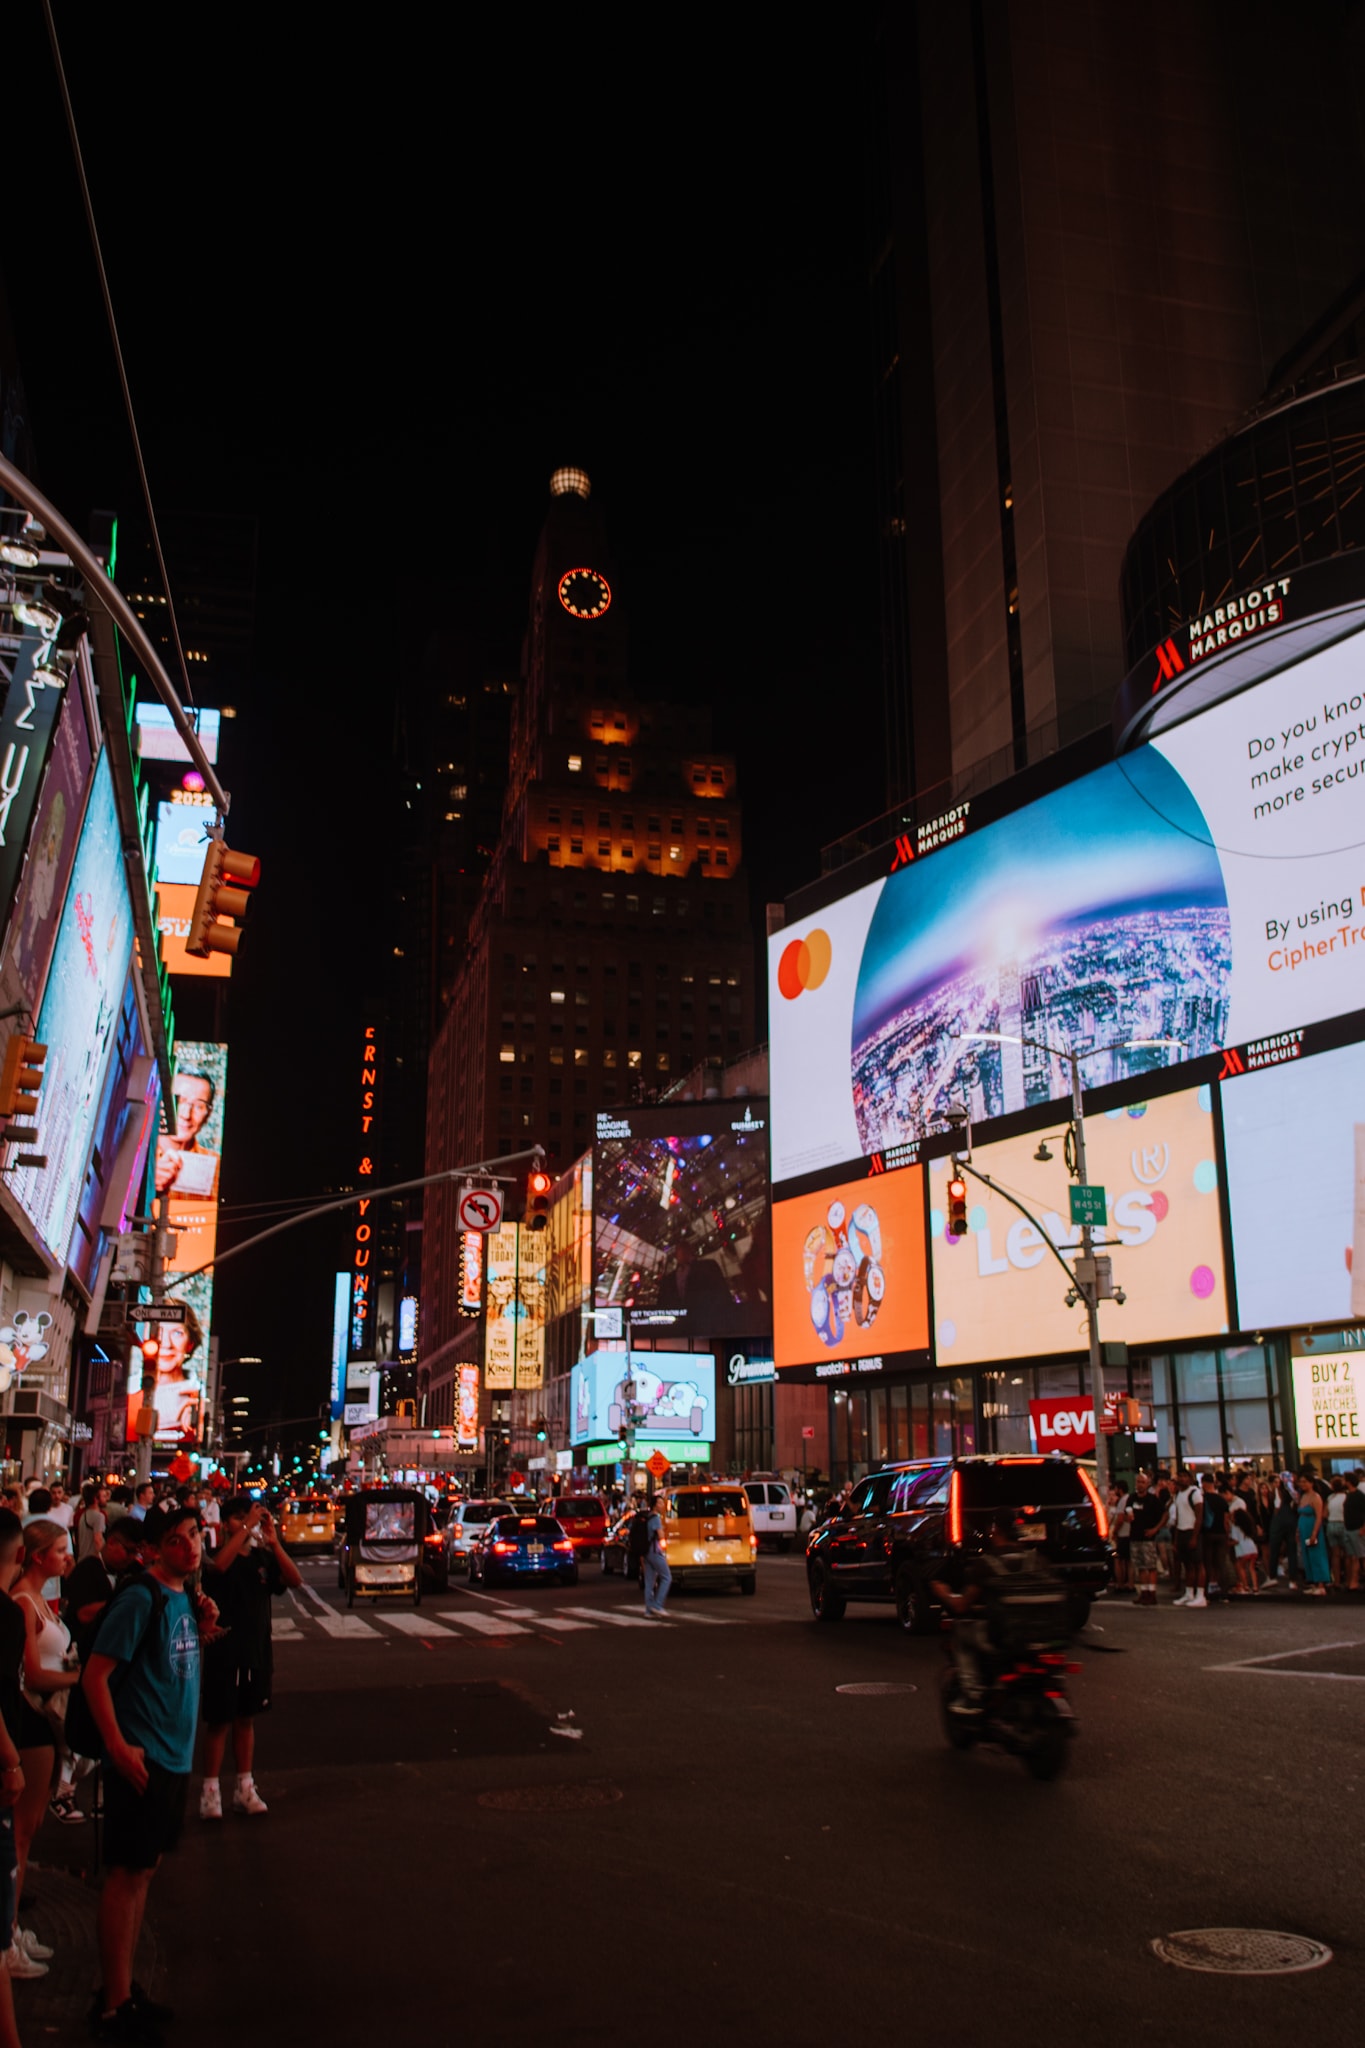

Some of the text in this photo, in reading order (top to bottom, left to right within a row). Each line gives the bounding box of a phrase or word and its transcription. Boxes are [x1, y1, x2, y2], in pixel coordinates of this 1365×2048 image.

[1189, 577, 1291, 640] MARRIOTT
[1190, 604, 1280, 660] MARQUIS
[1248, 692, 1365, 760] Do you kno
[1251, 755, 1304, 790] make
[171, 790, 214, 807] 2022
[1254, 787, 1305, 820] more
[917, 802, 970, 840] MARRIOTT
[918, 820, 965, 853] MARQUIS
[1265, 897, 1352, 941] By using
[1247, 1030, 1304, 1056] MARRIOTT
[1247, 1045, 1299, 1069] MARQUIS
[596, 1129, 632, 1140] WONDER
[355, 1027, 376, 1319] ERNST & YOUNG
[1082, 1189, 1093, 1198] TO
[135, 1307, 179, 1319] ONE WAY
[490, 1349, 509, 1360] LION
[487, 1363, 511, 1376] KING
[816, 1362, 844, 1377] swatch
[1311, 1362, 1337, 1383] BUY
[1312, 1397, 1357, 1411] WATCHES
[1314, 1412, 1360, 1439] FREE
